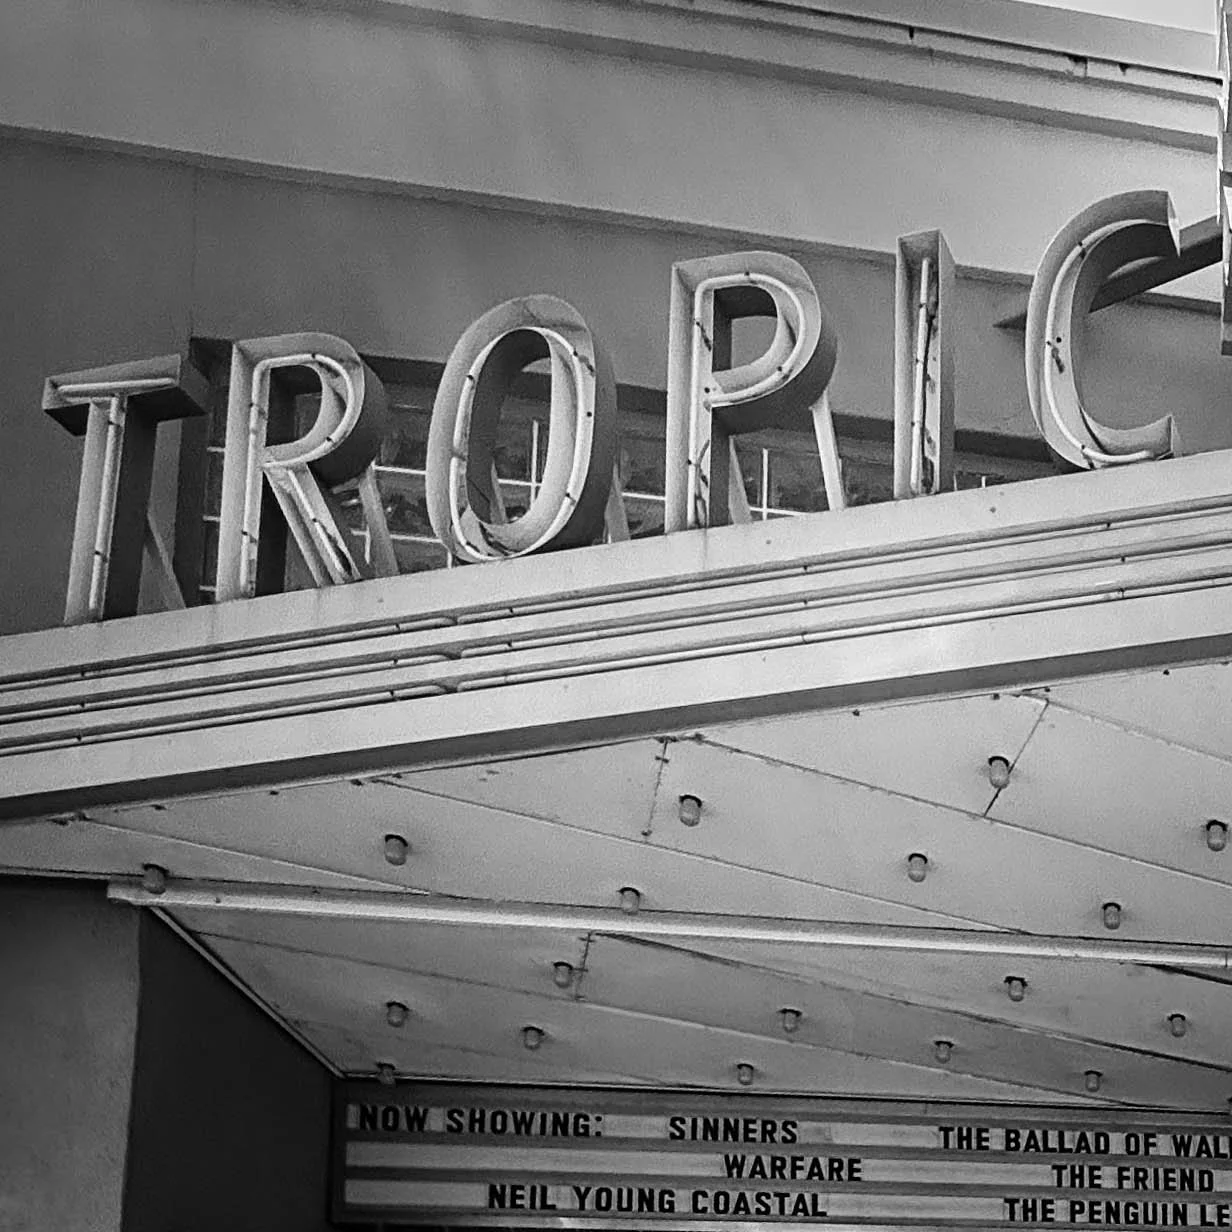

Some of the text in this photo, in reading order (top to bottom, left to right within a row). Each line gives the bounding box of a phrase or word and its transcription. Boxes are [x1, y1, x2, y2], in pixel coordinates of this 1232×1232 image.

[41, 189, 1184, 625] TROPIC
[358, 1105, 603, 1138] NOW SHOWING:
[669, 1116, 799, 1144] SINNERS
[939, 1126, 990, 1151] THE
[1004, 1129, 1110, 1155] BALLAD
[1124, 1132, 1158, 1156] OF
[724, 1154, 863, 1183] WARFARE
[1052, 1164, 1215, 1193] THE FRIEND
[487, 1183, 828, 1218] NEIL YOUNG COASTAL
[1004, 1198, 1056, 1223] THE
[1070, 1200, 1189, 1226] PENGUIN
